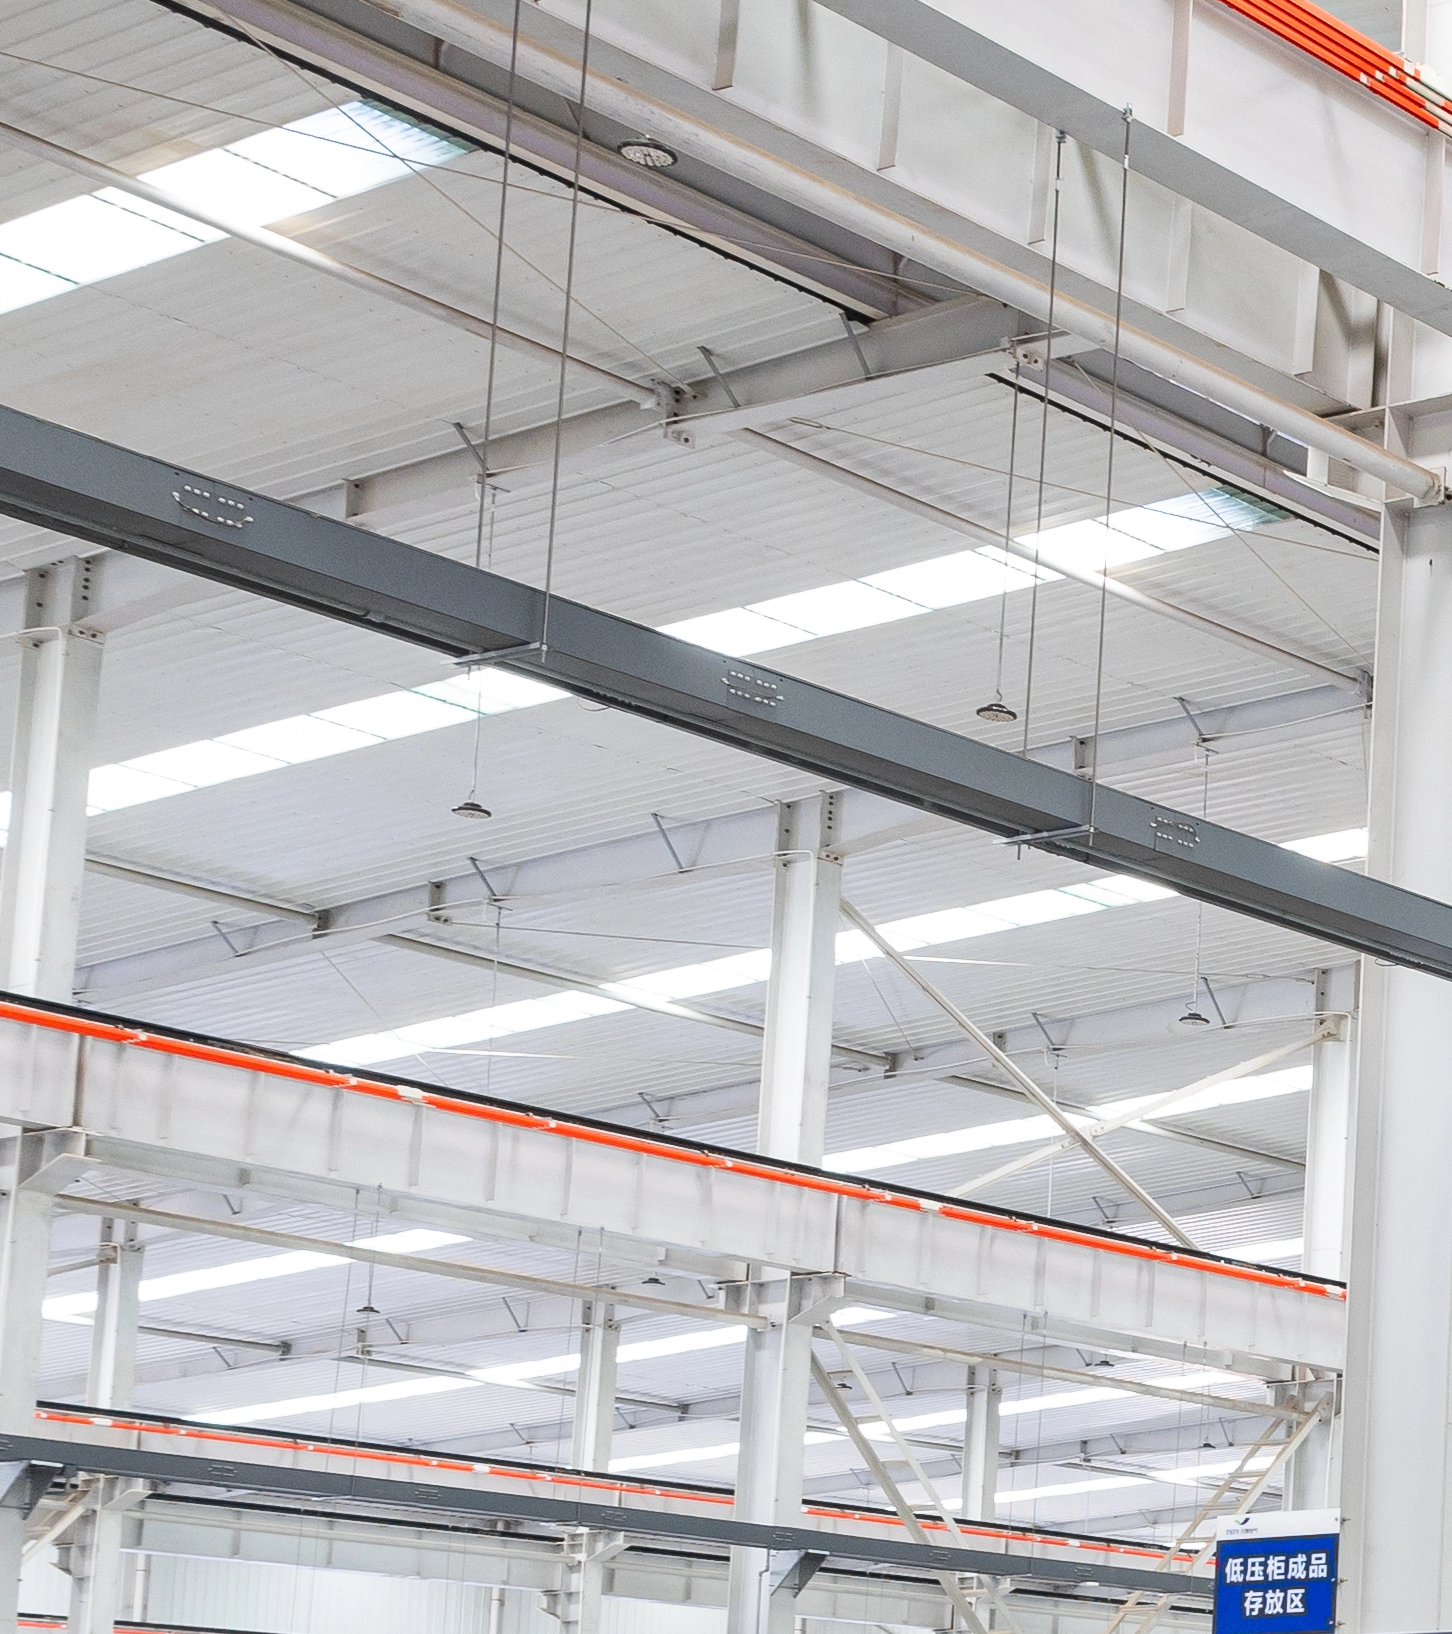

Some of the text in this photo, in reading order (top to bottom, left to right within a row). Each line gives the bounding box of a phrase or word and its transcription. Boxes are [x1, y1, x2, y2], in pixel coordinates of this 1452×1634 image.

[1225, 1552, 1328, 1583] 低压柜成品
[1243, 1588, 1306, 1616] 存放区
